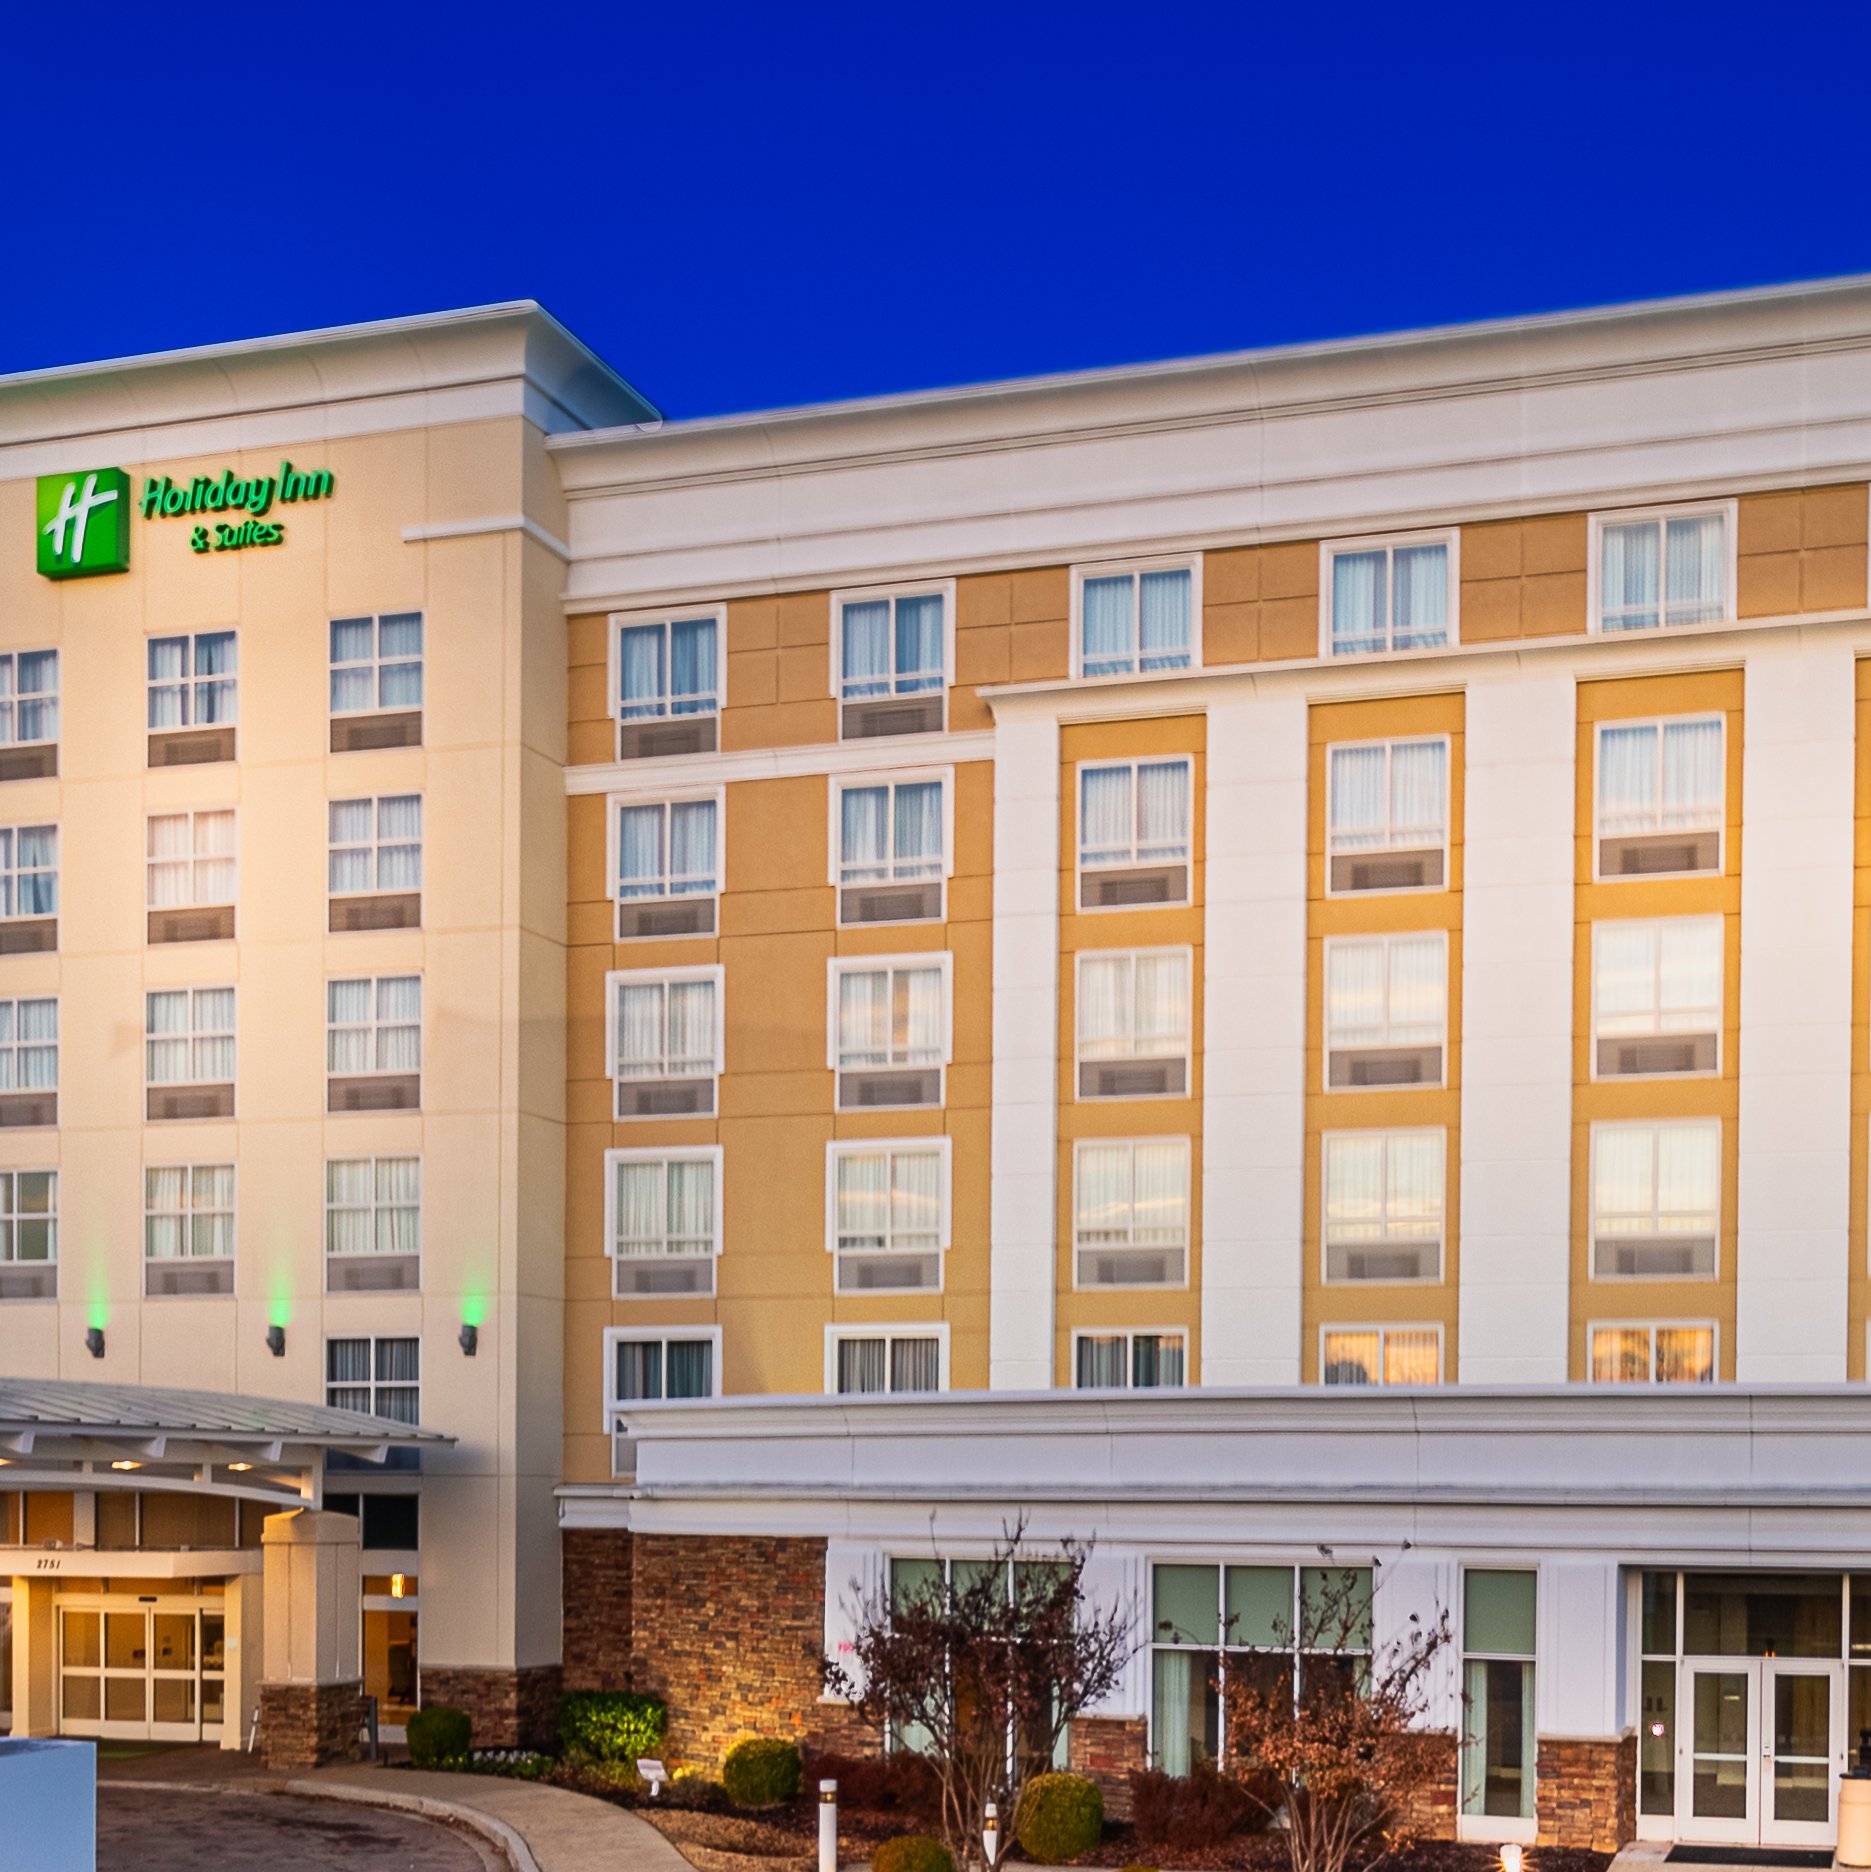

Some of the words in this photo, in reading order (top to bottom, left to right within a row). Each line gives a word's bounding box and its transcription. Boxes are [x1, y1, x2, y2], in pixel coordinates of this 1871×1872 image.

[140, 469, 273, 516] Holiday
[279, 460, 334, 503] Inn
[190, 525, 210, 552] &
[214, 520, 285, 550] Suites
[37, 1559, 60, 1569] 2751
